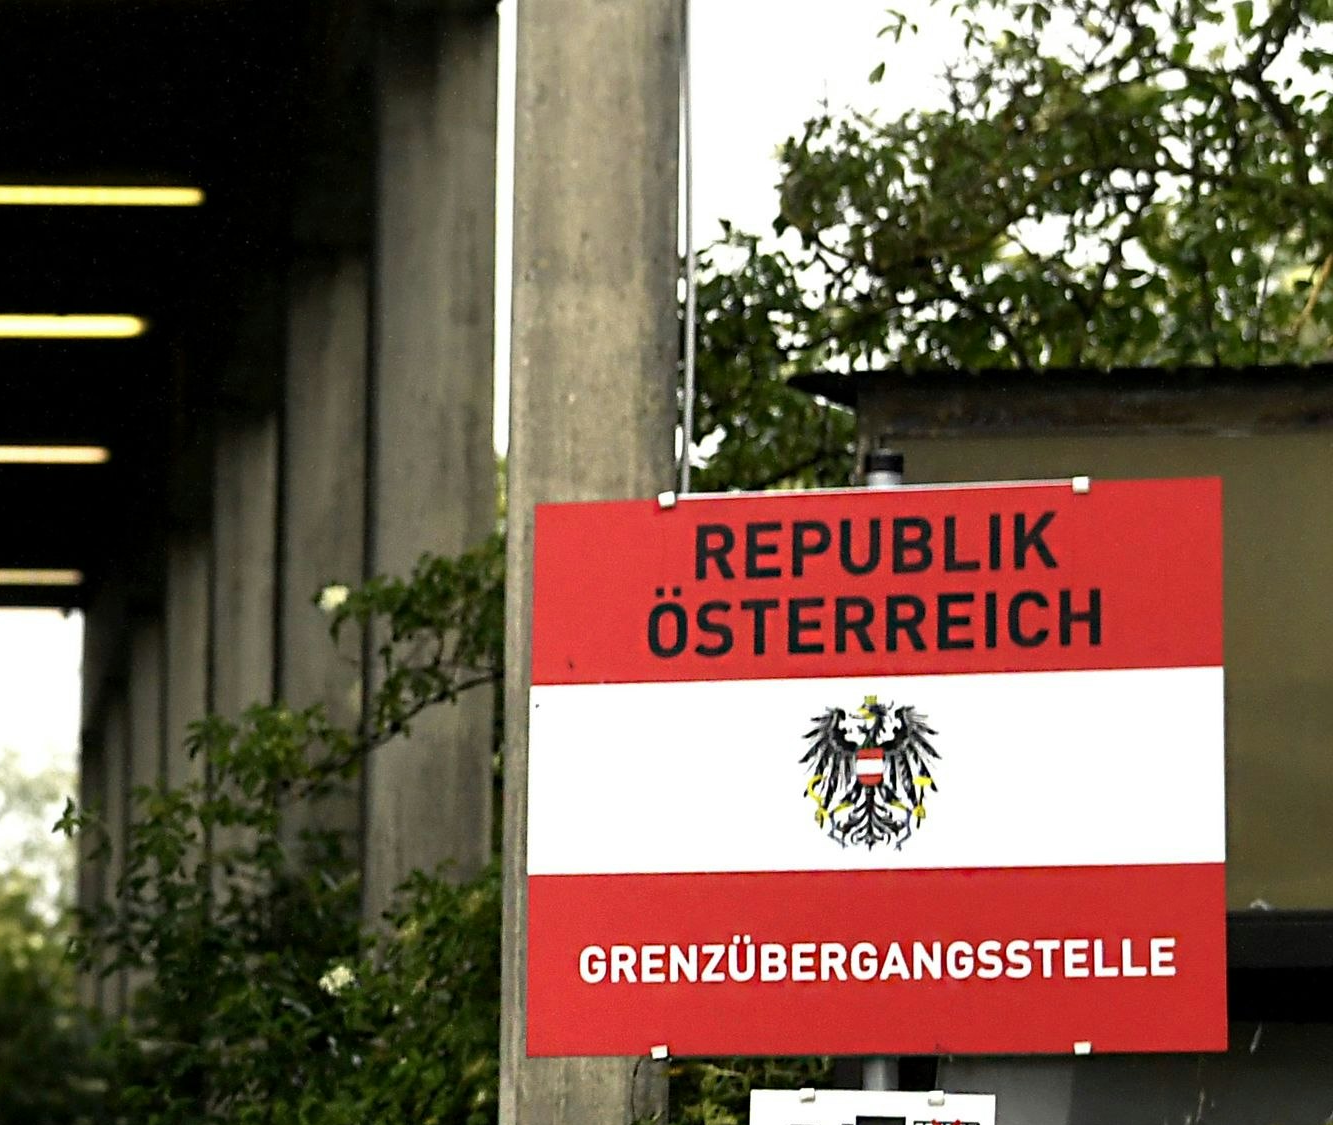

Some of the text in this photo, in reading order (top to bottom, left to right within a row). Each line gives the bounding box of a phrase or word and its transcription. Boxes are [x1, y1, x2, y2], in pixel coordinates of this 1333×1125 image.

[694, 511, 1058, 582] REPUBLIK
[646, 587, 1103, 658] ÖSTERREICH
[578, 935, 1177, 984] GRENZÜBERGANGSSTELLE
